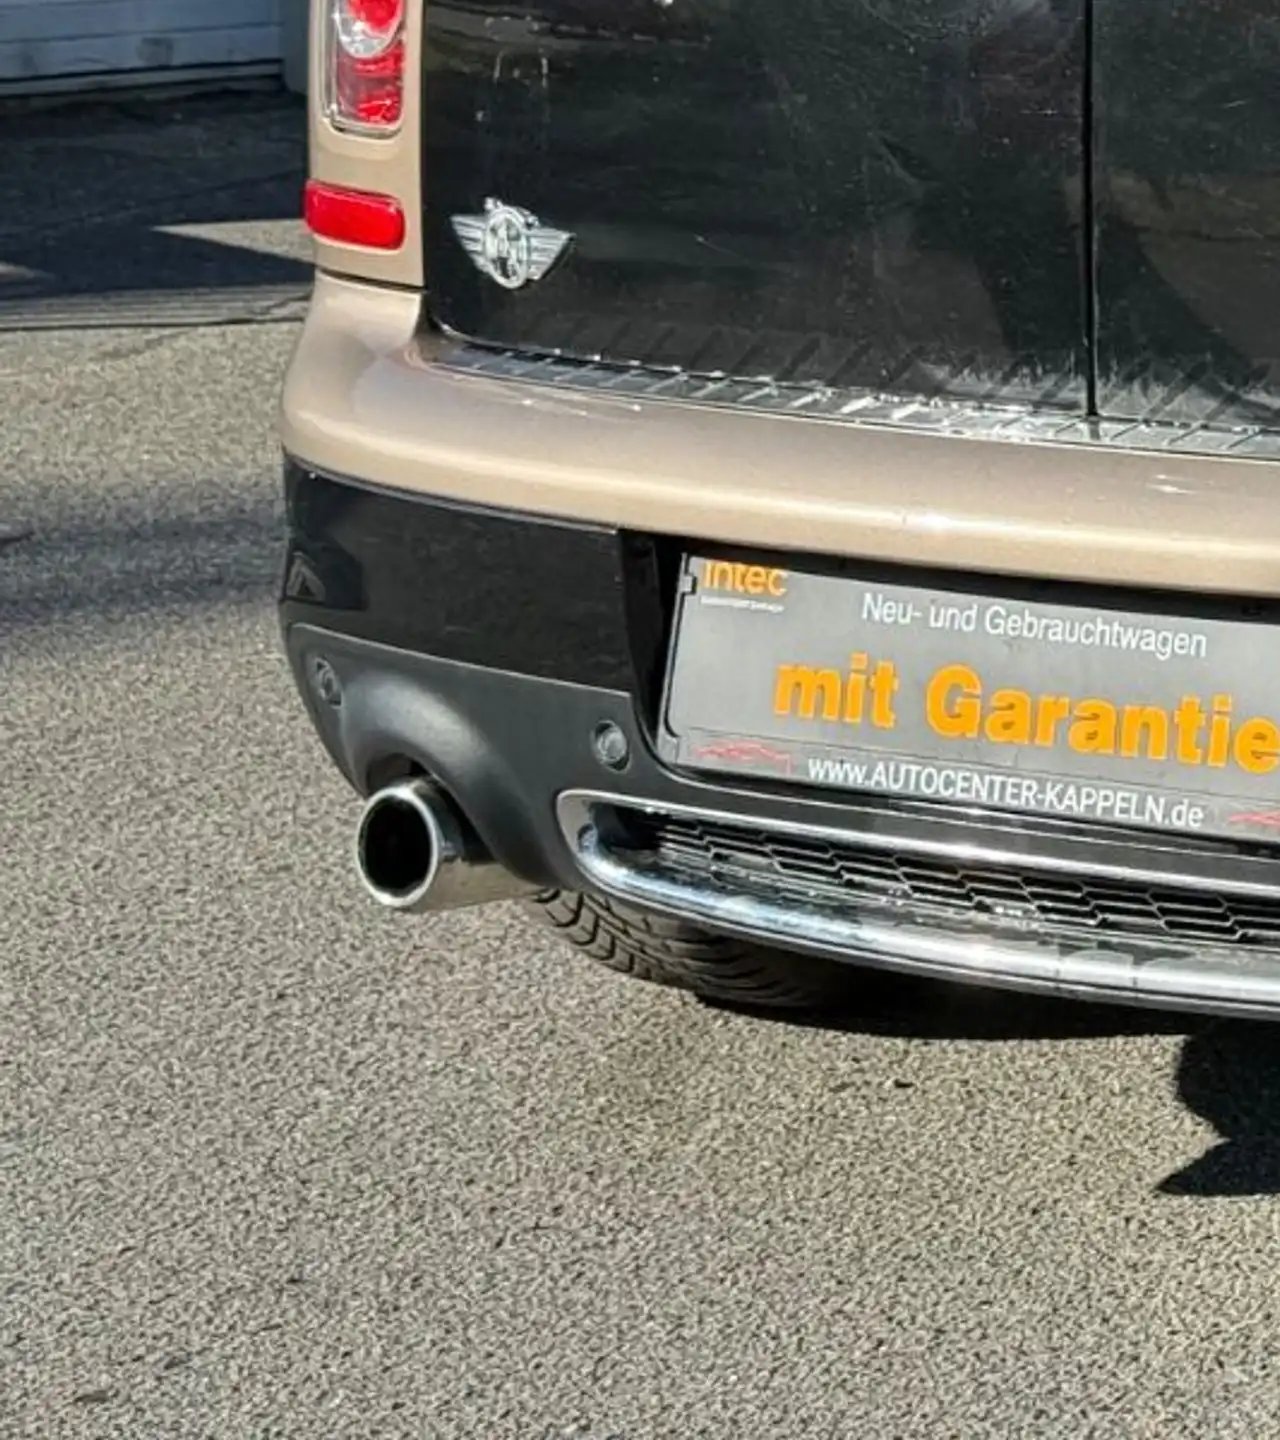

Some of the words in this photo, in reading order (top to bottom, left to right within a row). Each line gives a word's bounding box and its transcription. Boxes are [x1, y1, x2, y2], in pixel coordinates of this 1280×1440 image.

[862, 593, 922, 624] Neu-
[929, 603, 978, 632] und
[985, 604, 1207, 660] Gebrauchtwagen
[773, 651, 898, 729] mit
[807, 756, 1204, 828] www.AUTOCENTER-KAPPELN.de
